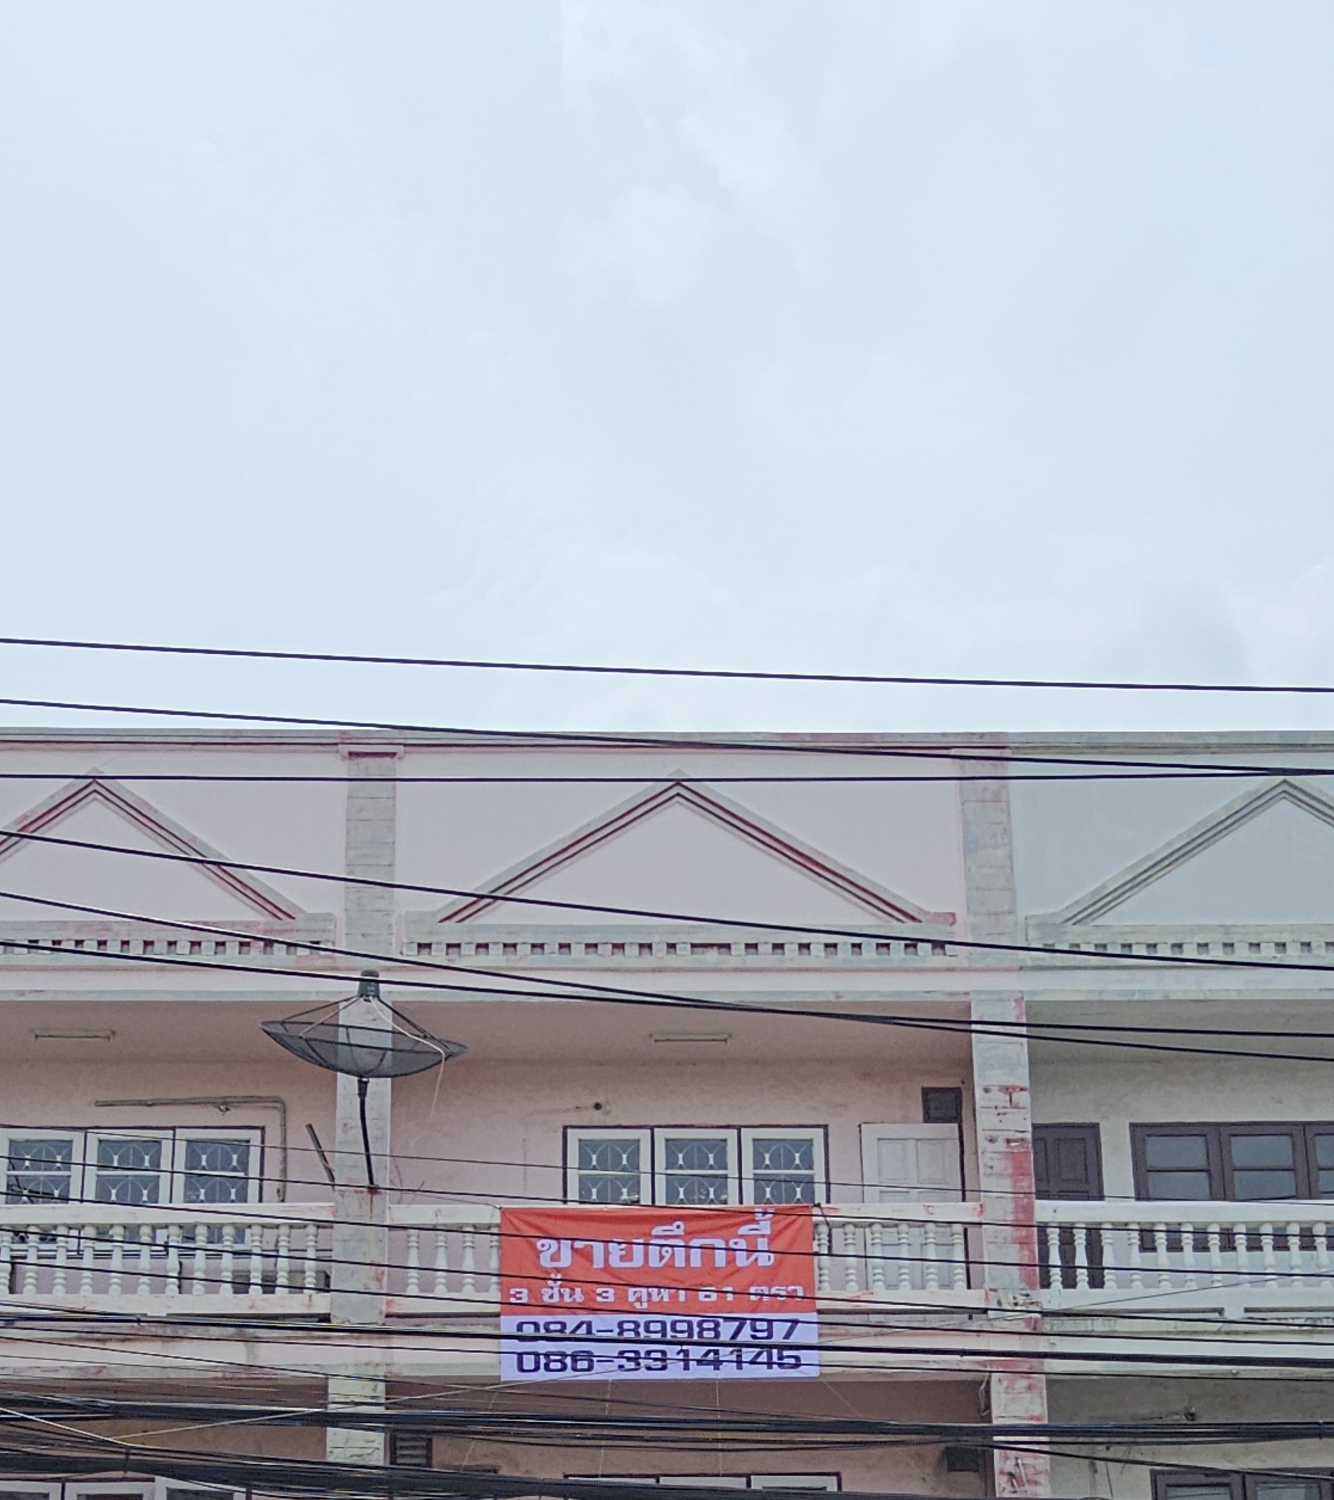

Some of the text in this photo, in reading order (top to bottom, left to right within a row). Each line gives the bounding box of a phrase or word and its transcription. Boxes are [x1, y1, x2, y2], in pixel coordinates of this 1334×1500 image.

[536, 1208, 776, 1269] ขายตึกนี้
[509, 1288, 529, 1303] 3
[541, 1272, 585, 1304] ชั้น
[595, 1287, 615, 1303] 3
[628, 1286, 686, 1309] คูหา
[516, 1318, 800, 1342] 084-8998797
